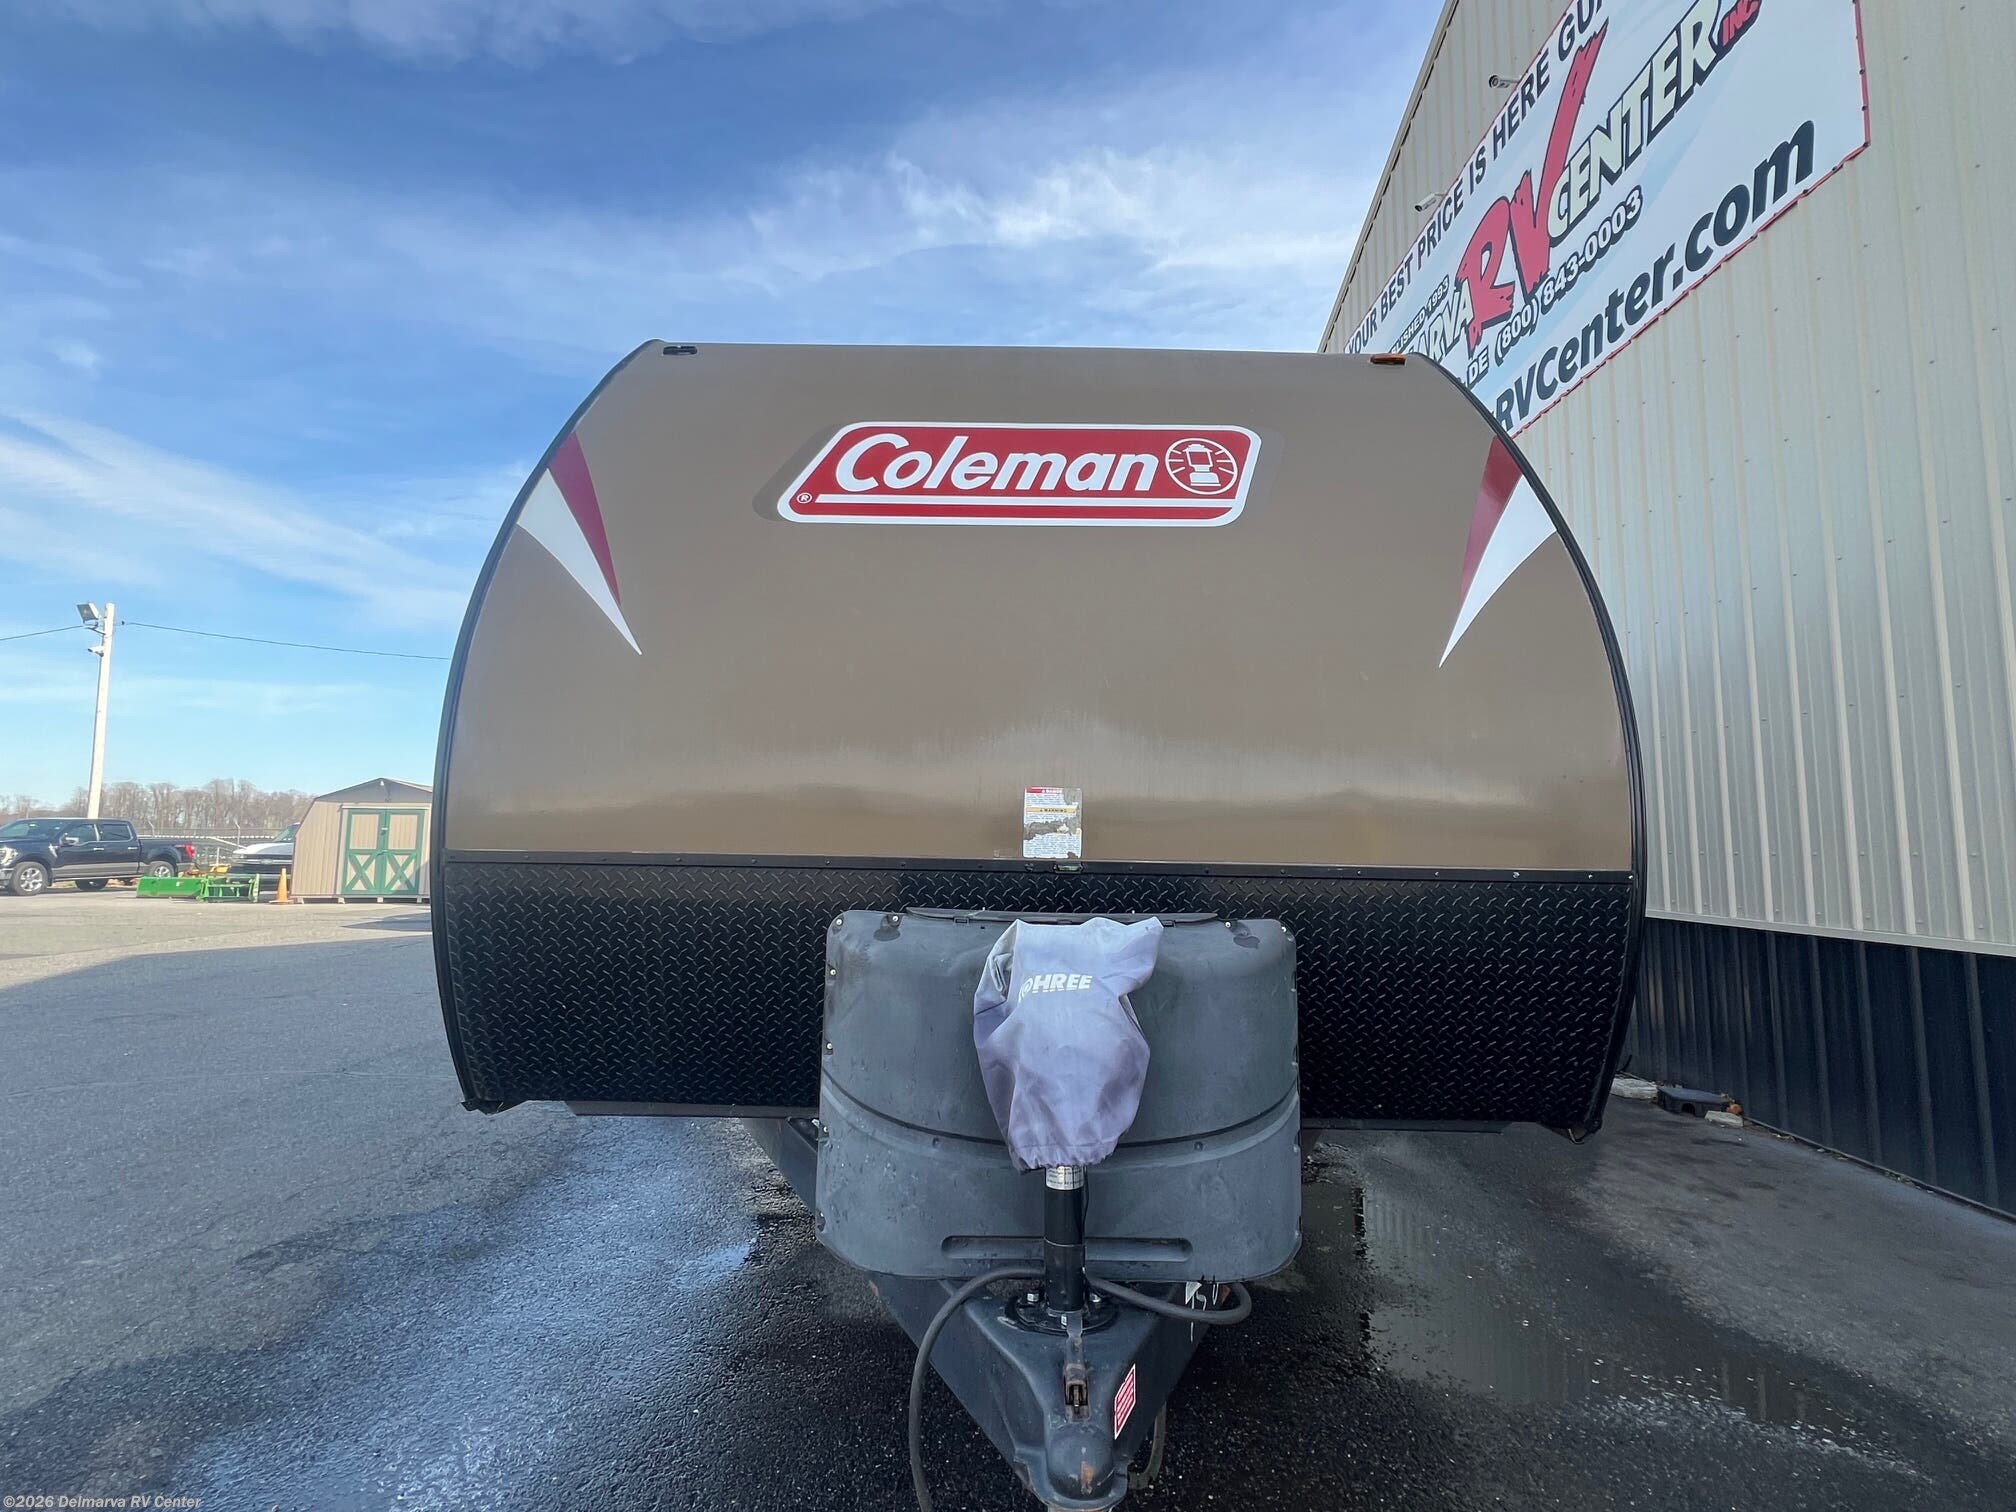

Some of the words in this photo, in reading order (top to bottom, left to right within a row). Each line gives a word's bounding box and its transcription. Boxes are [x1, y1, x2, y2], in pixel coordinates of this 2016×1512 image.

[1348, 307, 1378, 354] YOUR
[1380, 252, 1413, 323] BEST
[1417, 178, 1464, 272] PRICE
[1469, 145, 1487, 196] IS
[1493, 48, 1550, 162] HERE
[1558, 0, 1602, 61] GU
[1547, 0, 1721, 246] CENTER
[1426, 274, 1450, 319] 1993
[1467, 346, 1489, 388] DE
[1495, 296, 1540, 366] (800)
[1540, 186, 1642, 312] 843-0003
[1491, 120, 1815, 432] RVCenter.com
[835, 433, 1159, 493] Coleman
